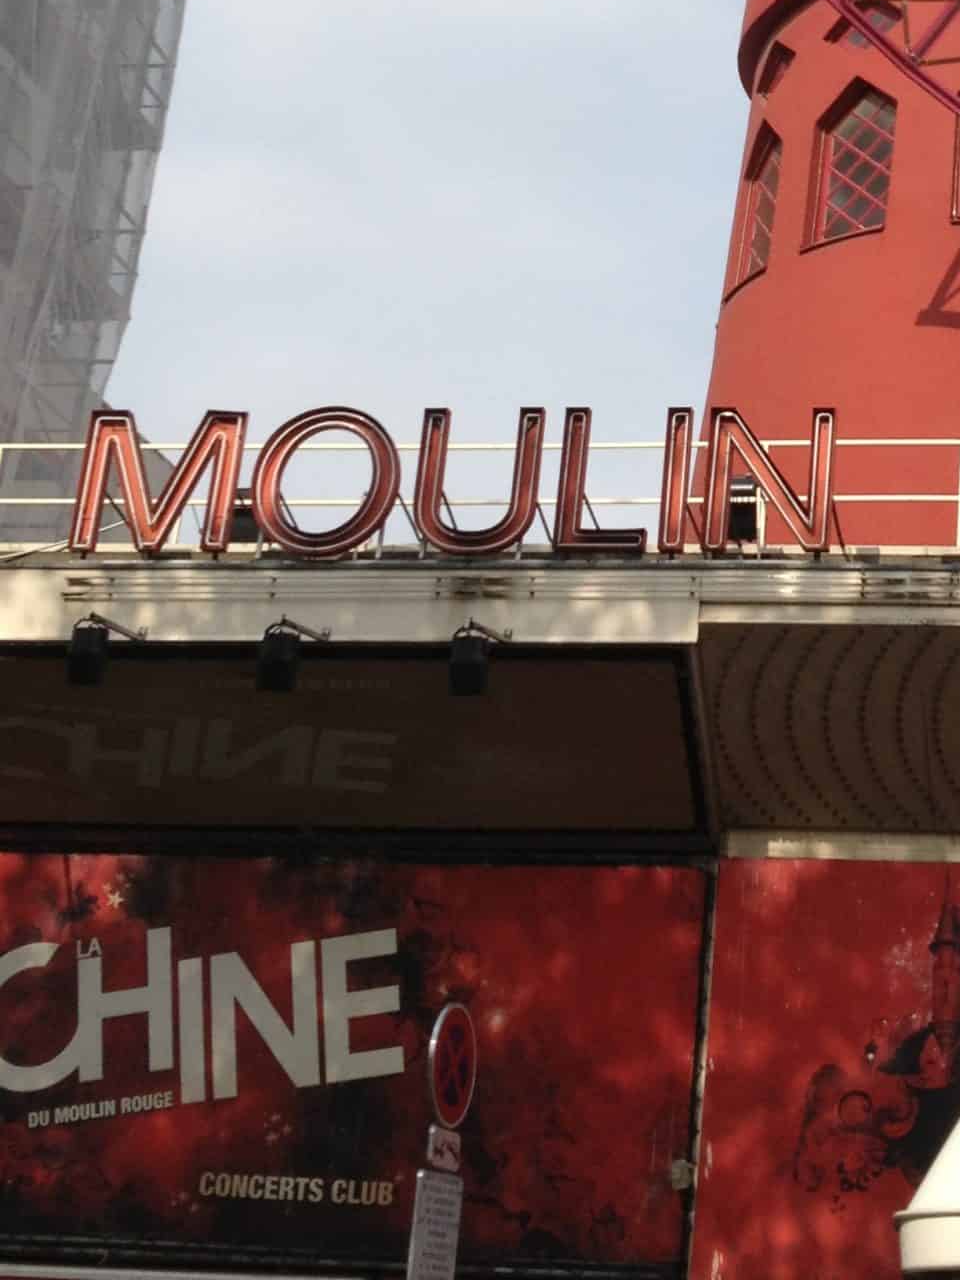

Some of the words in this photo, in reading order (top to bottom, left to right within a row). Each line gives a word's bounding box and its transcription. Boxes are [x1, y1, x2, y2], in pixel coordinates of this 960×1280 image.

[68, 406, 838, 558] MOULIN
[76, 937, 103, 959] LA
[28, 1109, 50, 1128] DU
[54, 1099, 116, 1124] MOULIN
[120, 1091, 174, 1114] ROUGE
[199, 1171, 324, 1202] CONCERTS
[331, 1179, 394, 1206] CLUB
